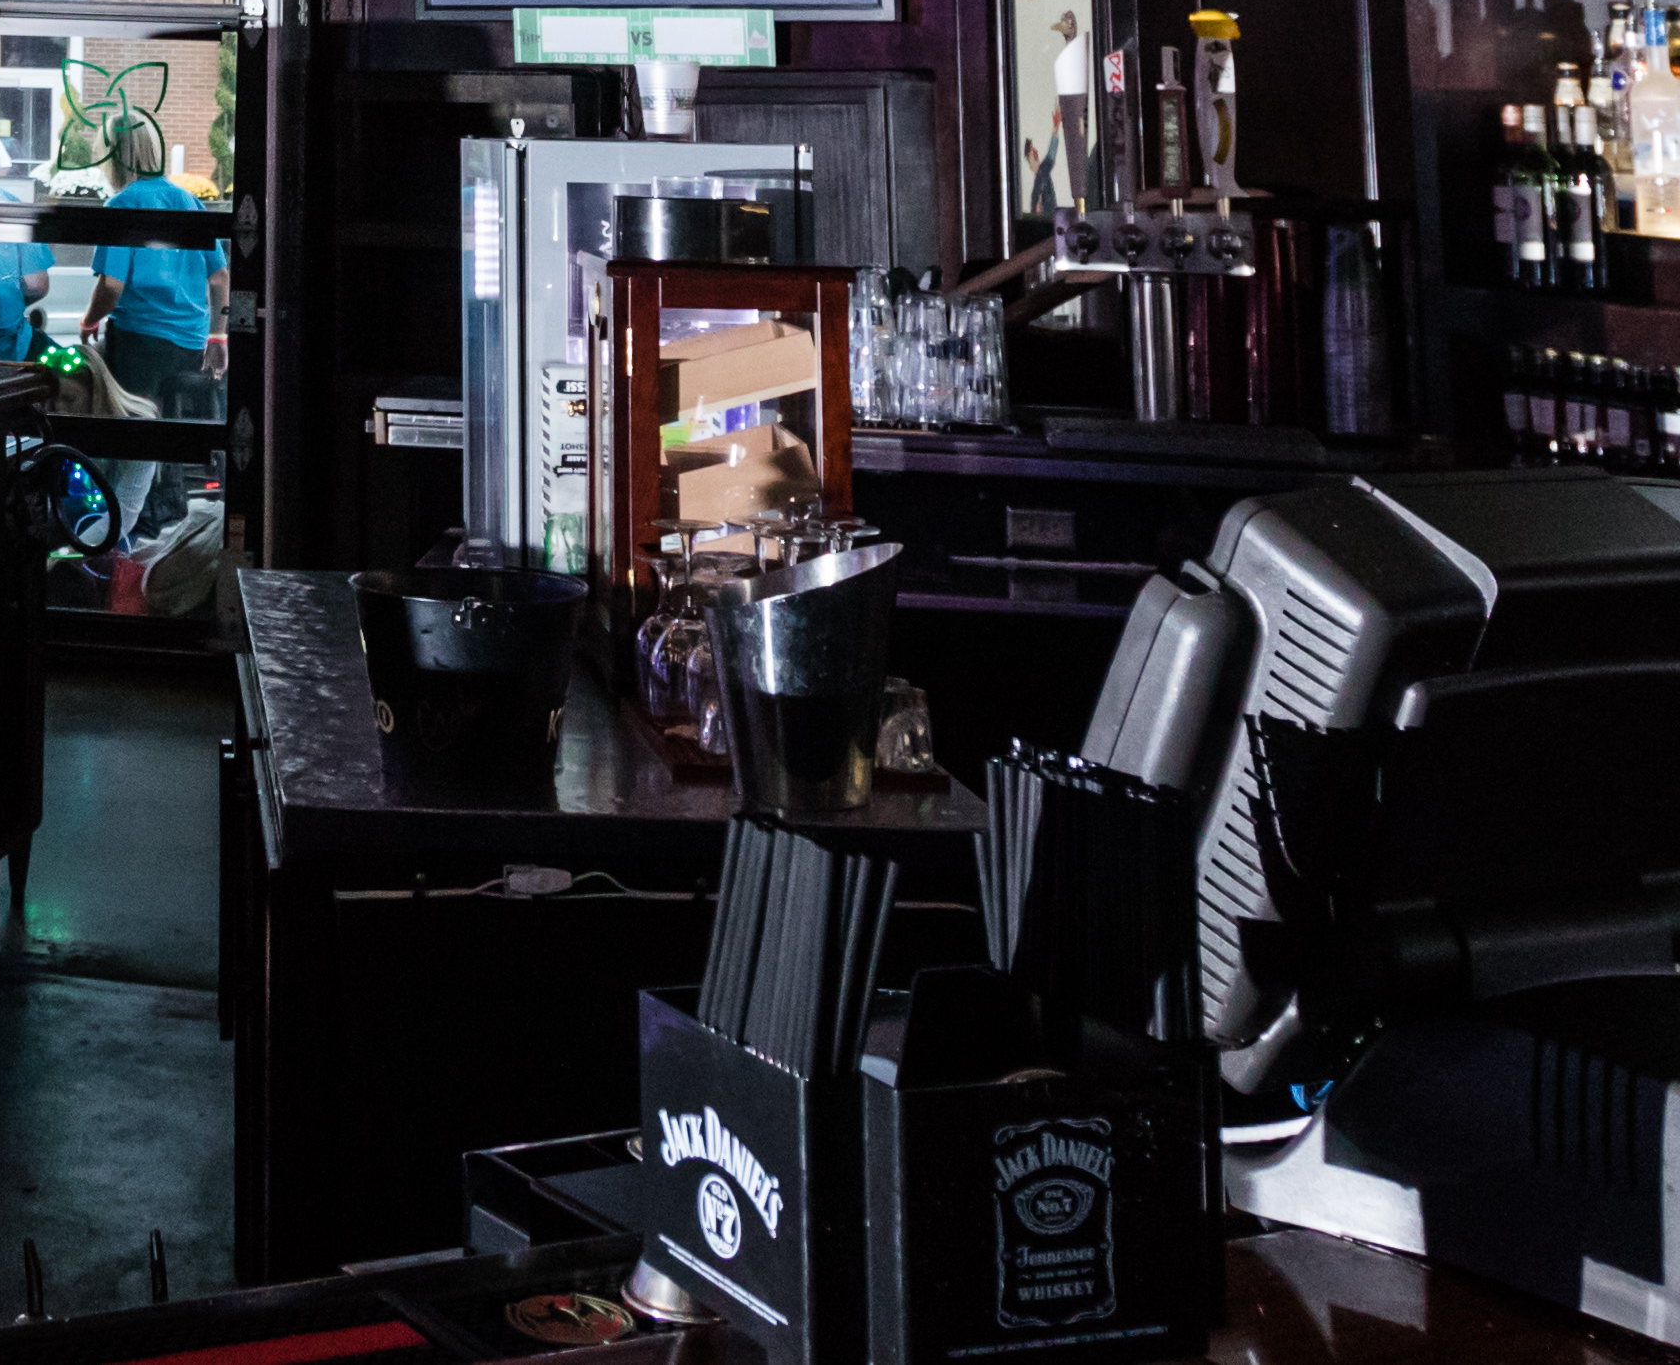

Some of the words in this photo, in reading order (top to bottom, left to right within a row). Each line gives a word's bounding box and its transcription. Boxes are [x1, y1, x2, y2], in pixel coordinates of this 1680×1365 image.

[630, 31, 653, 47] VS
[658, 1107, 708, 1168] JACK
[703, 1103, 785, 1241] DANIEL'S
[993, 1143, 1044, 1193] JACK
[1040, 1131, 1117, 1189] DANIEL'S
[1015, 1245, 1097, 1268] Tennessee
[1016, 1279, 1097, 1303] WHISKEY
